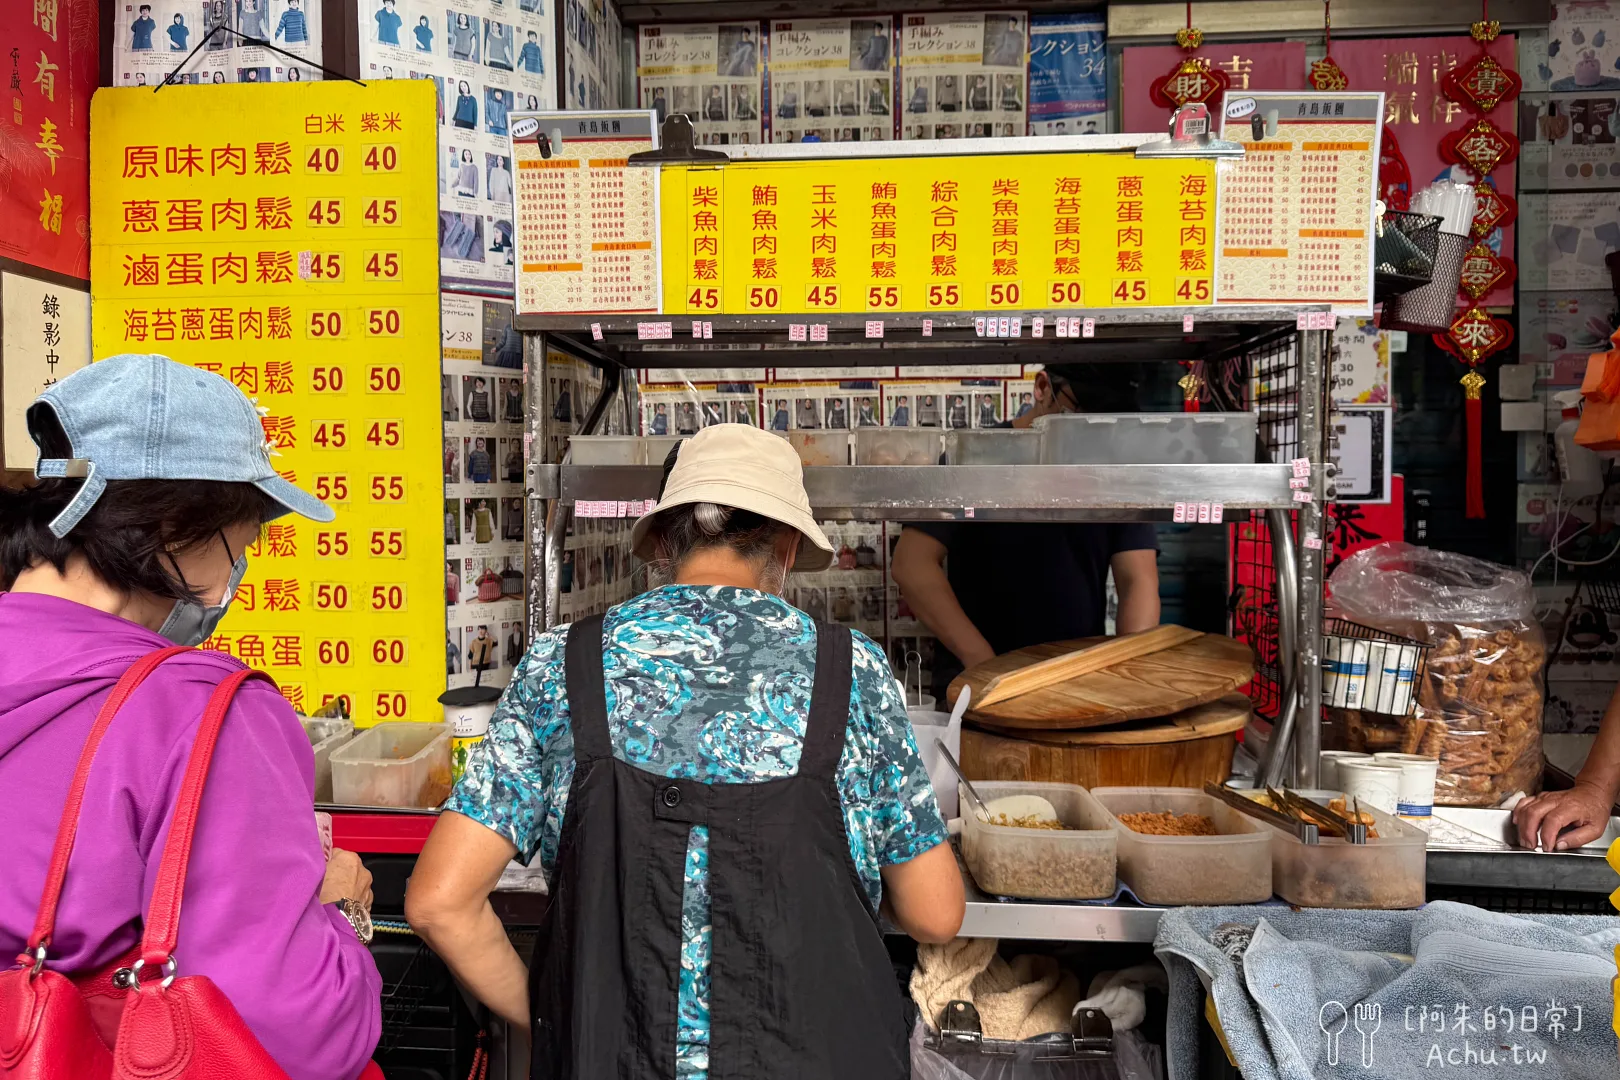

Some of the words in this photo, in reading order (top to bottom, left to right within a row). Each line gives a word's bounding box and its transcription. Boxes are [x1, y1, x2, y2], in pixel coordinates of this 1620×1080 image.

[645, 50, 698, 62] コレクション
[776, 45, 829, 57] コレクション
[908, 39, 962, 51] コレクション
[1079, 56, 1106, 79] 34
[1175, 75, 1207, 99] 財
[306, 114, 344, 133] 白米
[361, 113, 401, 132] 紫米
[123, 142, 291, 178] 原味肉鬆
[307, 148, 339, 172] 40
[365, 146, 396, 170] 40
[122, 197, 292, 232] 蔥蛋肉鬆
[309, 201, 340, 224] 45
[365, 200, 397, 224] 45
[1055, 178, 1080, 274] 海苔蛋肉鬆
[1117, 176, 1143, 271] 蔥蛋肉鬆
[1180, 175, 1206, 270] 海苔肉鬆
[693, 186, 718, 280] 柴魚肉鬆
[752, 185, 777, 278] 鮪魚肉鬆
[812, 185, 836, 277] 玉米肉鬆
[872, 182, 896, 277] 鮪魚蛋肉鬆
[932, 181, 958, 276] 綜合肉鬆
[993, 179, 1018, 275] 柴魚蛋肉鬆
[123, 251, 293, 286] 滷蛋肉鬆
[311, 253, 340, 279] 45
[366, 253, 398, 277] 45
[689, 289, 718, 308] 45
[751, 288, 777, 307] 50
[808, 286, 837, 305] 45
[870, 287, 897, 306] 55
[930, 286, 958, 305] 55
[991, 284, 1019, 304] 50
[1052, 283, 1080, 302] 50
[1115, 281, 1146, 300] 45
[1177, 280, 1208, 300] 45
[124, 307, 292, 341] 海苔蔥蛋肉鬆
[312, 312, 341, 336] 50
[370, 310, 399, 334] 50
[41, 293, 62, 388] 錄影中
[458, 331, 473, 343] 38
[313, 367, 343, 391] 50
[370, 367, 400, 391] 50
[314, 424, 346, 447] 45
[367, 422, 399, 446] 45
[317, 476, 347, 500] 55
[372, 477, 403, 500] 55
[318, 532, 348, 556] 55
[371, 532, 402, 555] 55
[318, 585, 347, 608] 50
[372, 586, 402, 609] 50
[319, 641, 349, 664] 60
[373, 640, 403, 663] 60
[377, 694, 406, 717] 50
